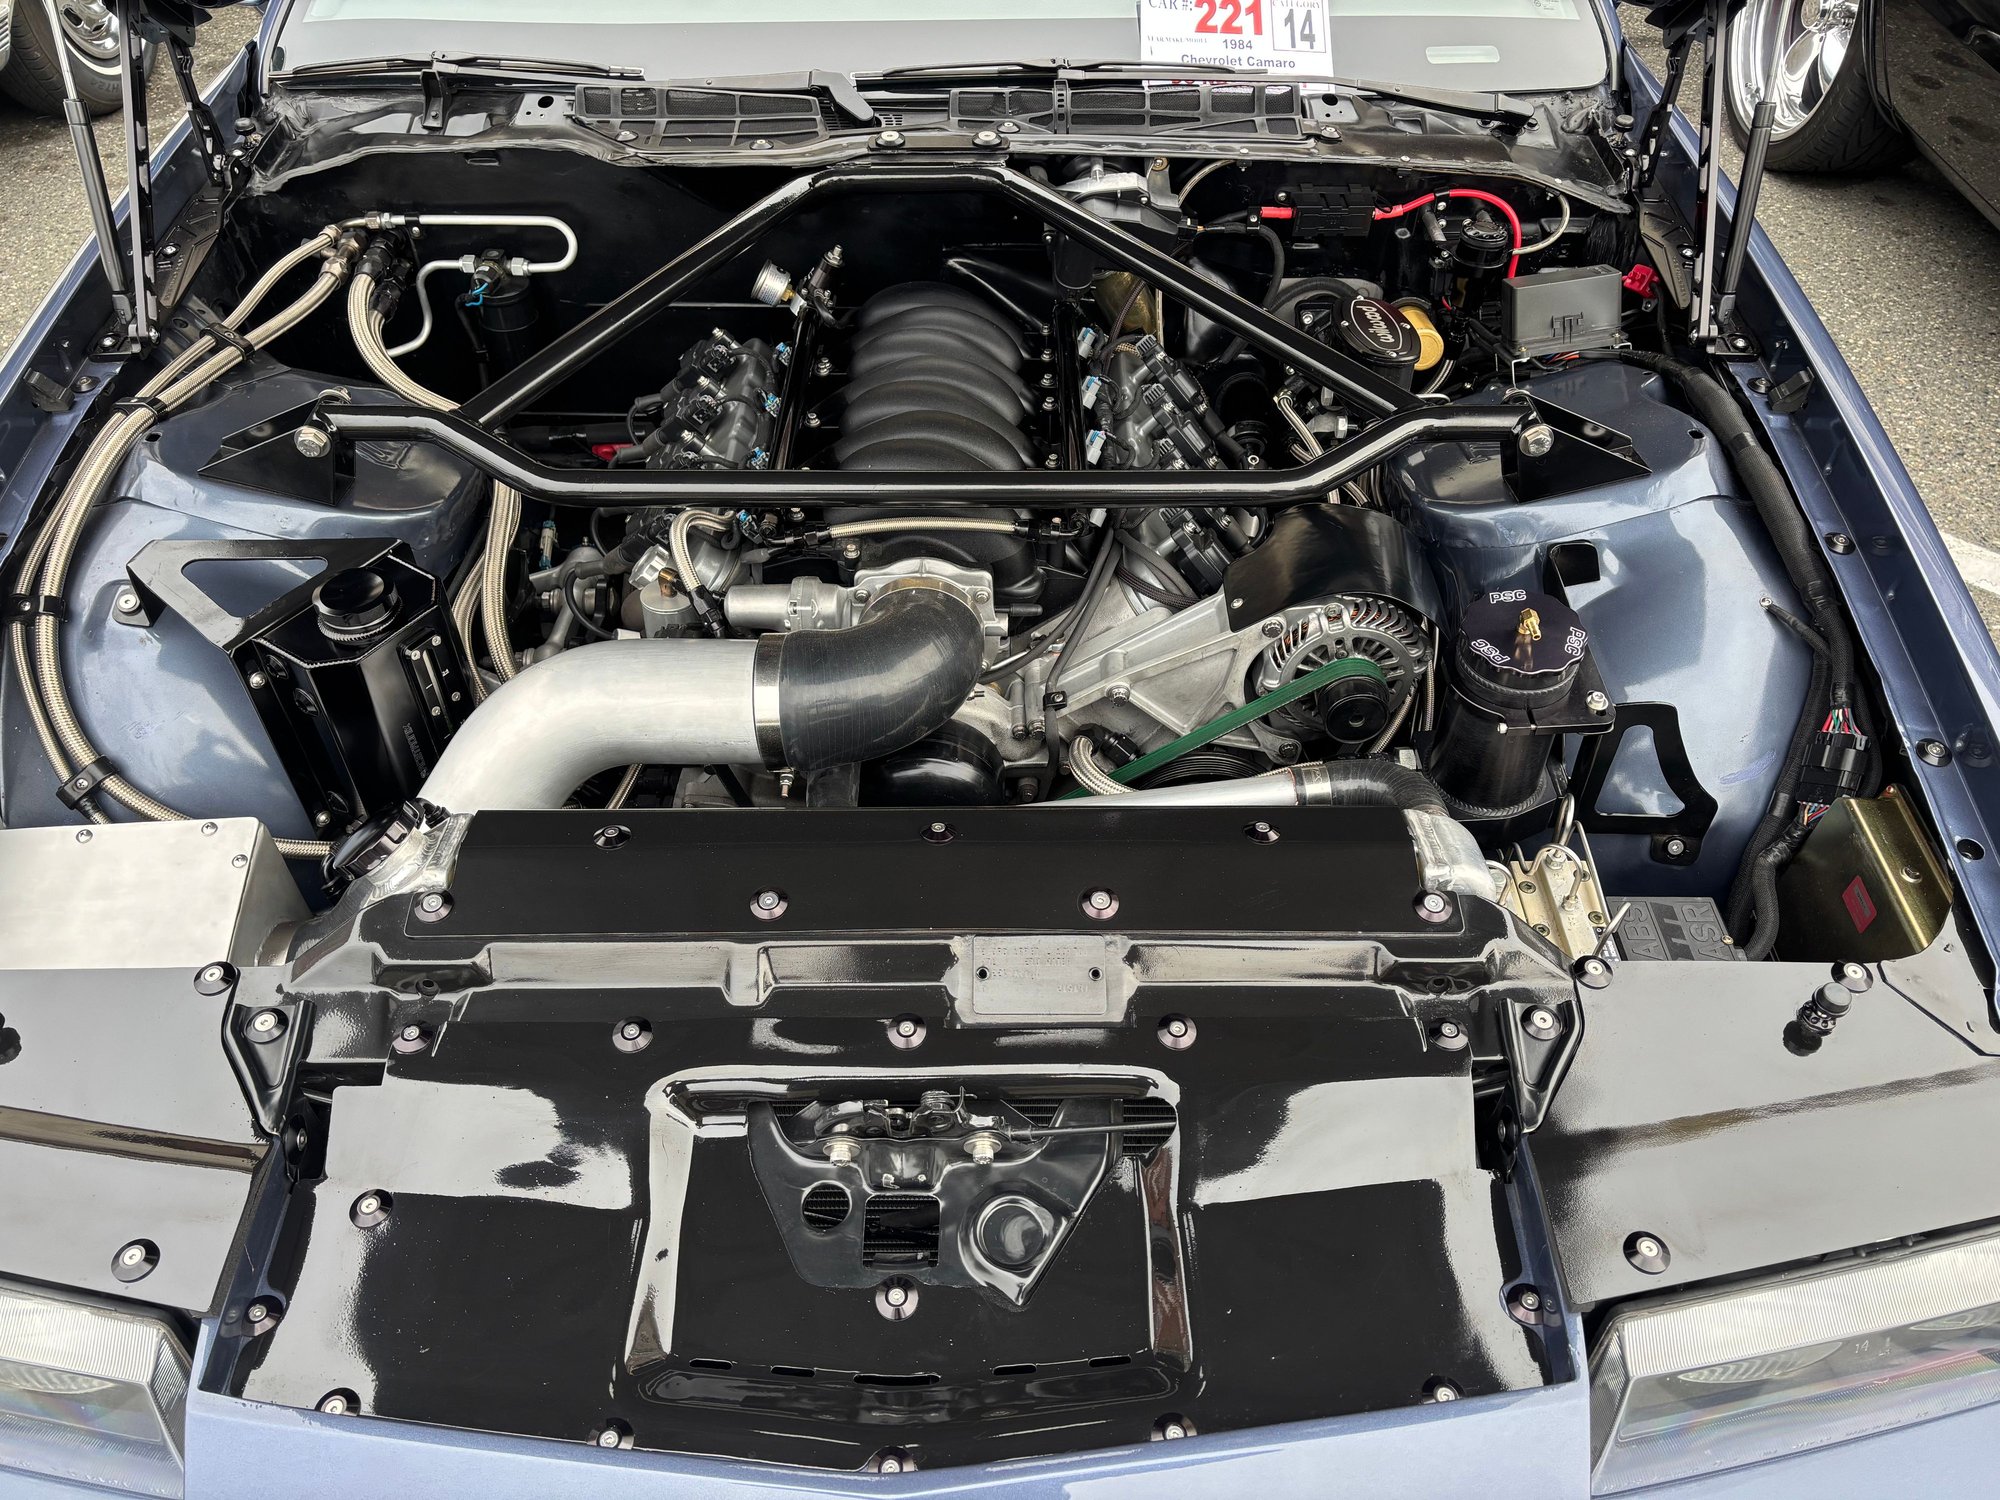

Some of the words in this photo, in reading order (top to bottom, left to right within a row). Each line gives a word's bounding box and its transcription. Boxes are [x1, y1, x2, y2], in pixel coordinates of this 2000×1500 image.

[1149, 0, 1177, 10] CAR
[1194, 0, 1263, 35] 221
[1284, 8, 1316, 49] 14
[1222, 39, 1253, 50] 1984
[1181, 54, 1242, 66] Chevrolet
[1247, 56, 1296, 68] Camaro
[1355, 305, 1395, 343] wilwood
[1489, 590, 1527, 603] PSC
[1471, 639, 1510, 664] PSC
[1565, 627, 1586, 656] PSC
[1617, 903, 1664, 960] ABS
[1681, 904, 1731, 960] ASR
